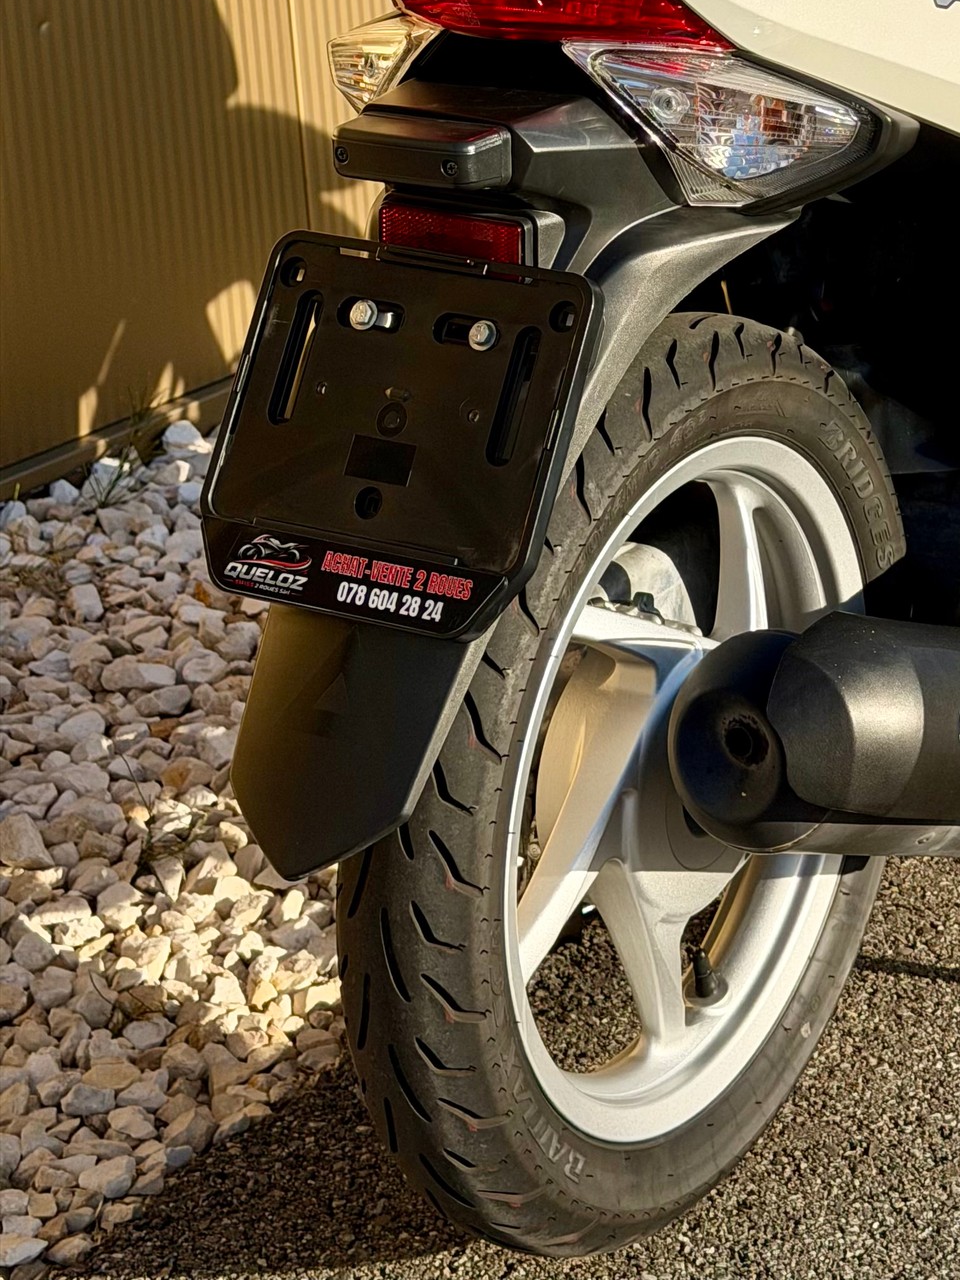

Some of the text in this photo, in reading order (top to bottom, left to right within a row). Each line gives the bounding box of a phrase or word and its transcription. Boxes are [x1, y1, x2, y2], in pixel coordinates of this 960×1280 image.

[224, 561, 309, 591] QUELOZ
[259, 584, 279, 593] ROUES
[321, 550, 473, 601] ACHAT-VENTE 2 ROUES
[336, 581, 444, 622] 078 604 28 24
